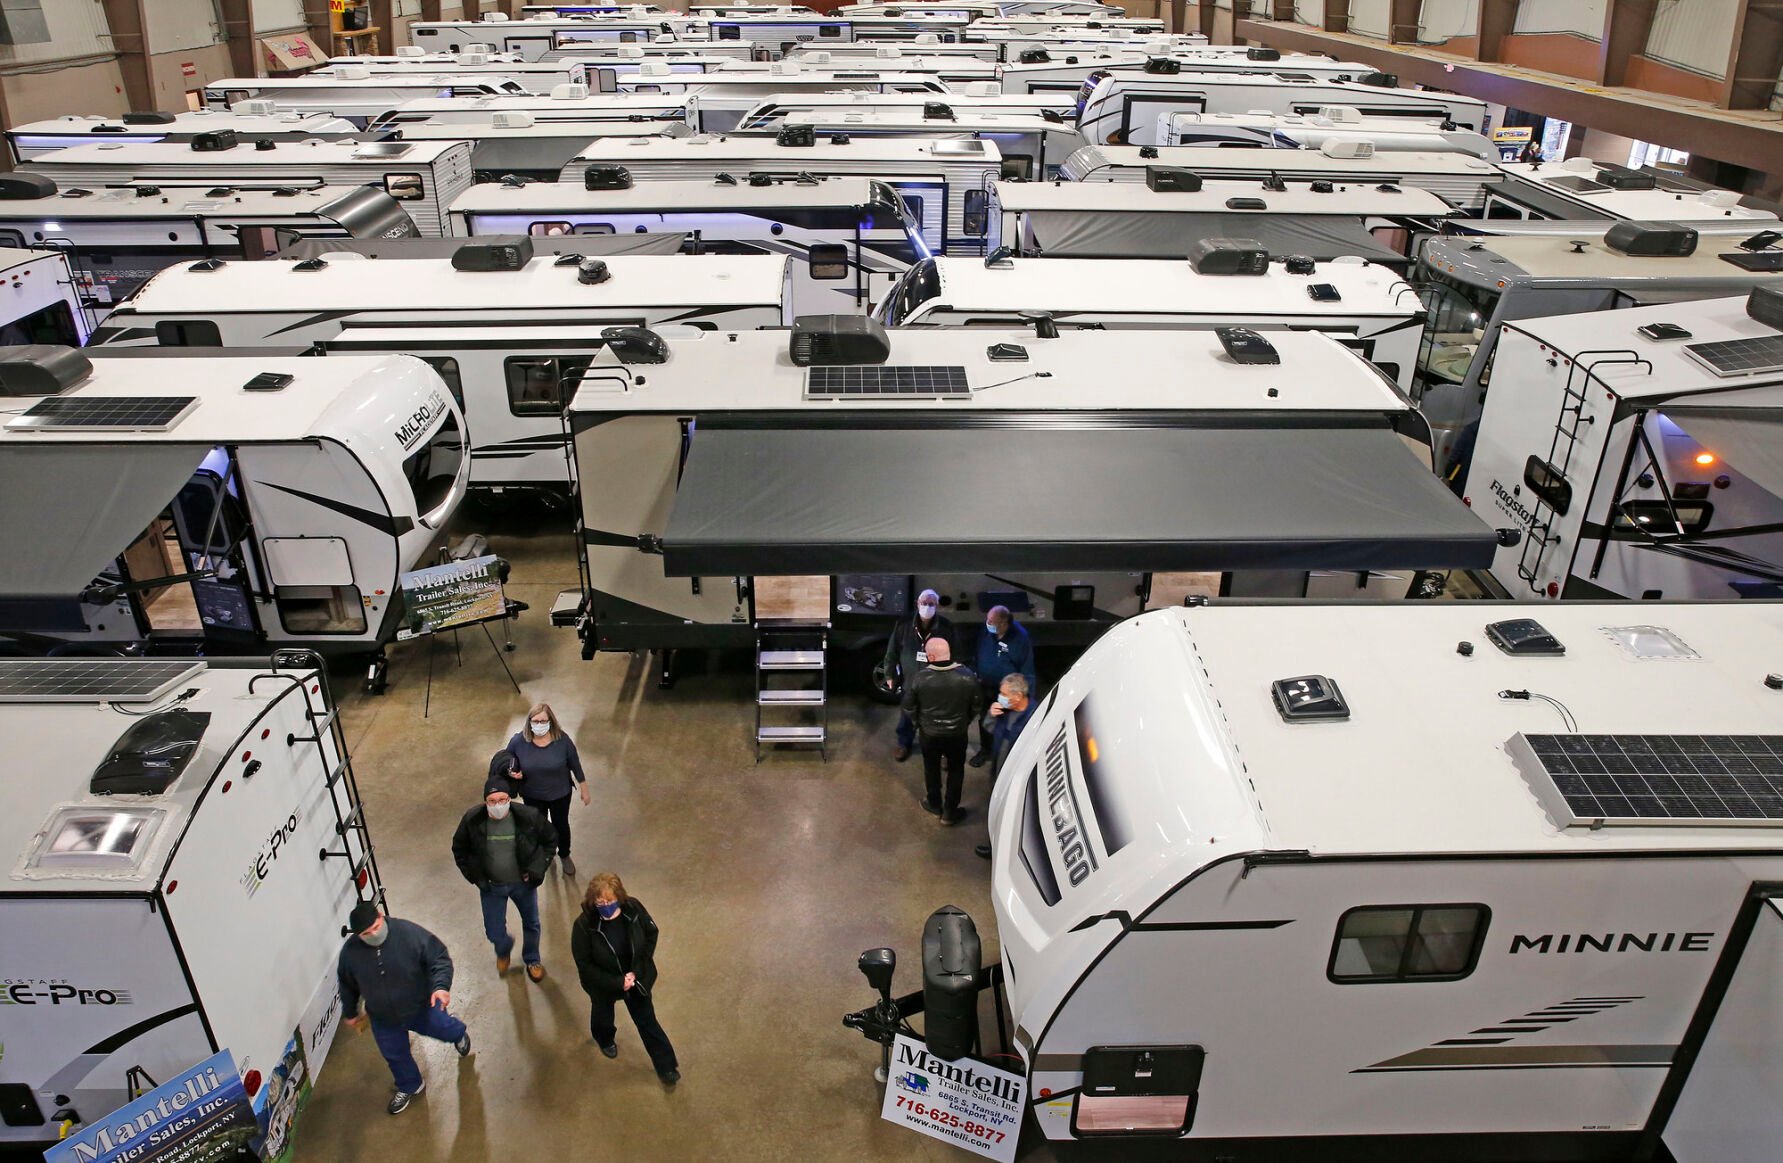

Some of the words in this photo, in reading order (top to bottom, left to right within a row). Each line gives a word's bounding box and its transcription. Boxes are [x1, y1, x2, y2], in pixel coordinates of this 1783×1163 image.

[412, 562, 489, 592] Mantelli
[416, 590, 446, 602] Trailer
[1046, 720, 1091, 888] WINNEBAGO
[257, 814, 297, 880] E-Pro
[1509, 932, 1716, 954] MINNIE
[9, 984, 117, 1005] E-Pro
[896, 1042, 1021, 1104] Mantelli
[938, 1077, 970, 1095] Trailer
[972, 1089, 999, 1107] Sales,
[1001, 1100, 1019, 1113] Inc.
[938, 1091, 959, 1104] 6865
[960, 1099, 969, 1107] S.
[972, 1102, 1001, 1118] Transit
[1002, 1113, 1017, 1125] Rd.
[949, 1102, 988, 1122] Lockport,
[990, 1116, 1004, 1126] NY
[70, 1066, 222, 1163] Mantelli
[149, 1113, 197, 1147] Sales,
[197, 1096, 229, 1117] Inc.
[896, 1095, 1006, 1144] 716-625-8877
[905, 1113, 991, 1151] www.mantelli.com
[156, 1146, 182, 1163] Road,
[182, 1122, 222, 1149] Lockport,
[222, 1111, 236, 1124] NY
